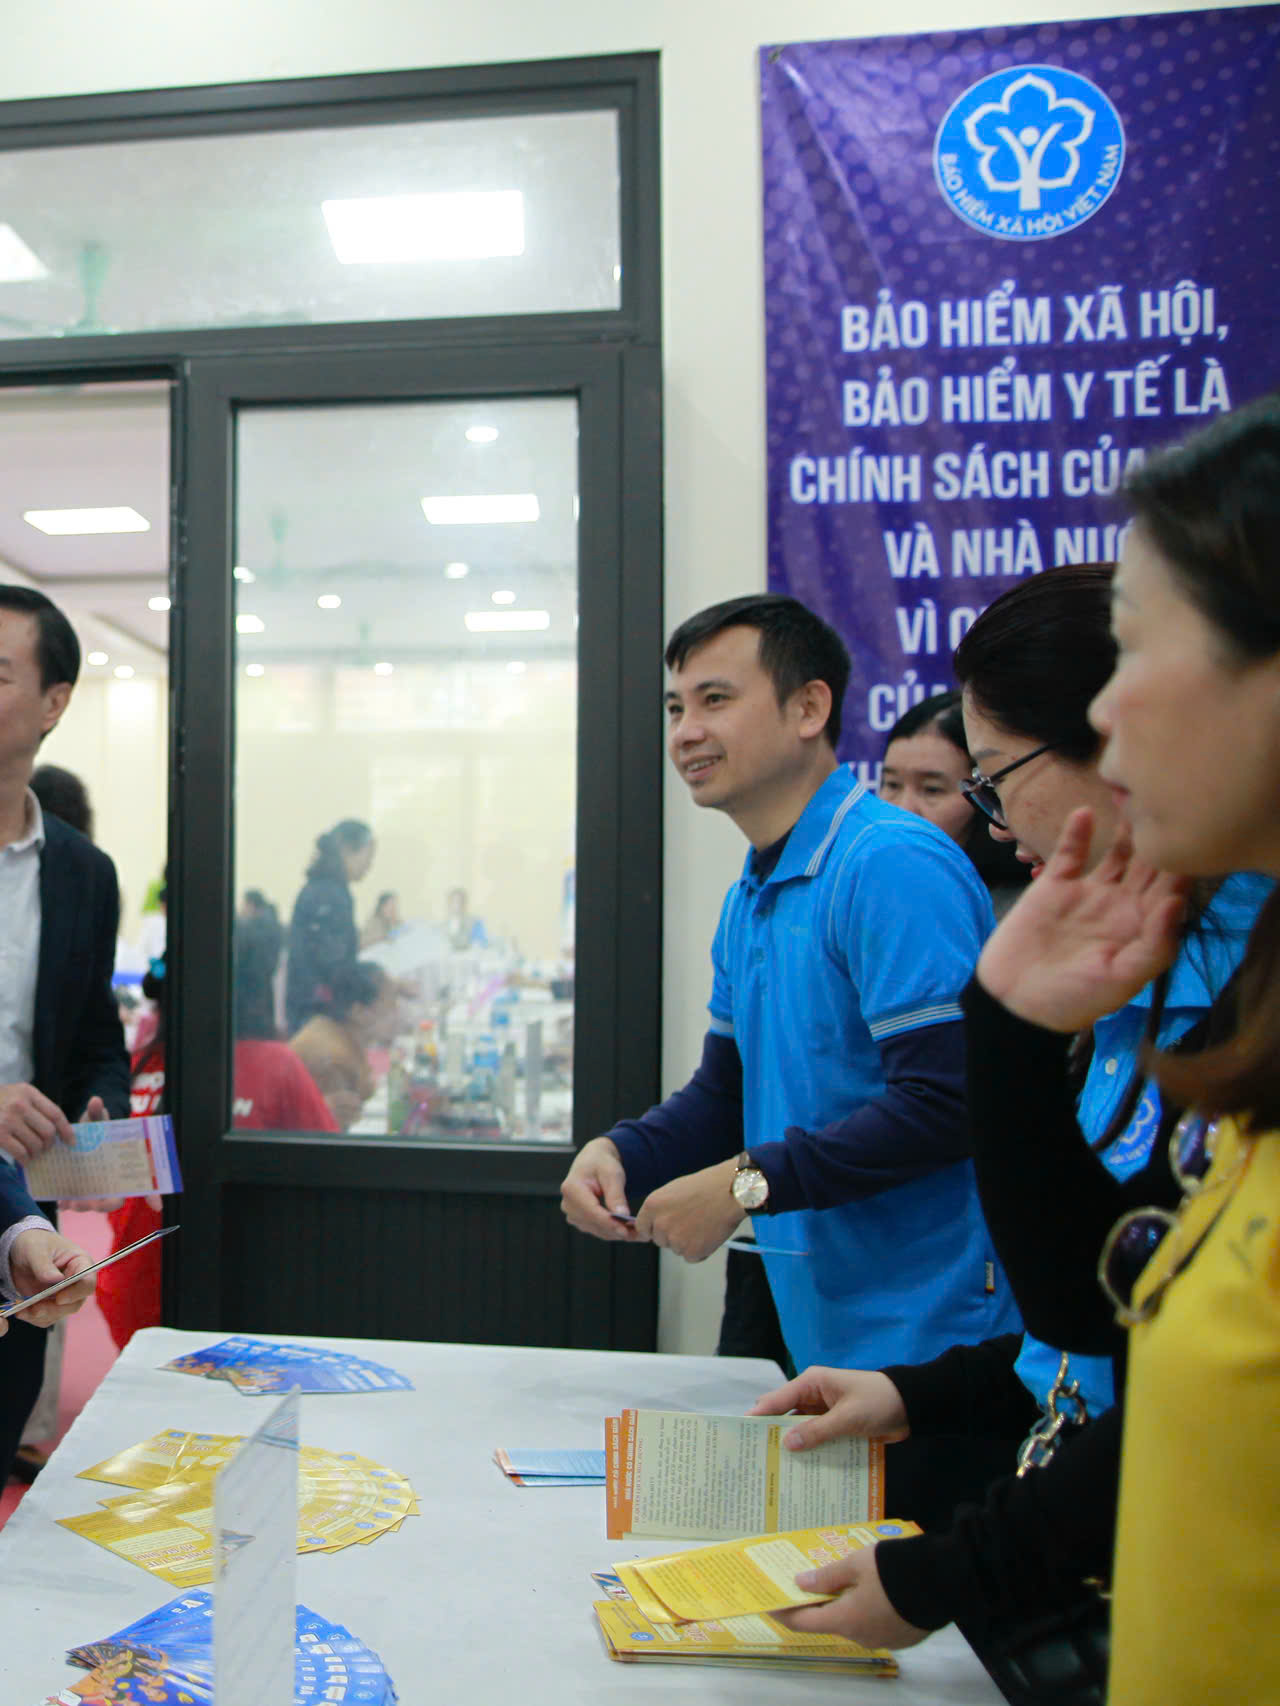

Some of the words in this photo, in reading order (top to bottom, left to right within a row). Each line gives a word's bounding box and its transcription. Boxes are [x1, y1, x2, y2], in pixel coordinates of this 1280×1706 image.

[941, 153, 962, 192] BẢO
[954, 190, 994, 226] HIỂM
[996, 214, 1023, 233] XÃ
[1027, 213, 1064, 233] HỘI
[1064, 186, 1101, 221] VIỆT
[1096, 144, 1120, 186] NAM
[842, 288, 928, 352] BẢO
[940, 280, 1050, 347] HIỂM
[1063, 285, 1127, 343] XÃ
[1140, 280, 1228, 345] HỘI,
[843, 366, 929, 427] BẢO
[942, 357, 1050, 423] HIỂM
[1063, 372, 1094, 419] Y
[1106, 355, 1171, 416] TẾ
[1174, 357, 1231, 413] LÀ
[790, 446, 920, 503] CHÍNH
[933, 443, 1049, 500] SÁCH
[884, 523, 939, 578] VÀ
[952, 519, 1042, 576] NHÀ
[898, 599, 937, 655] VÌ
